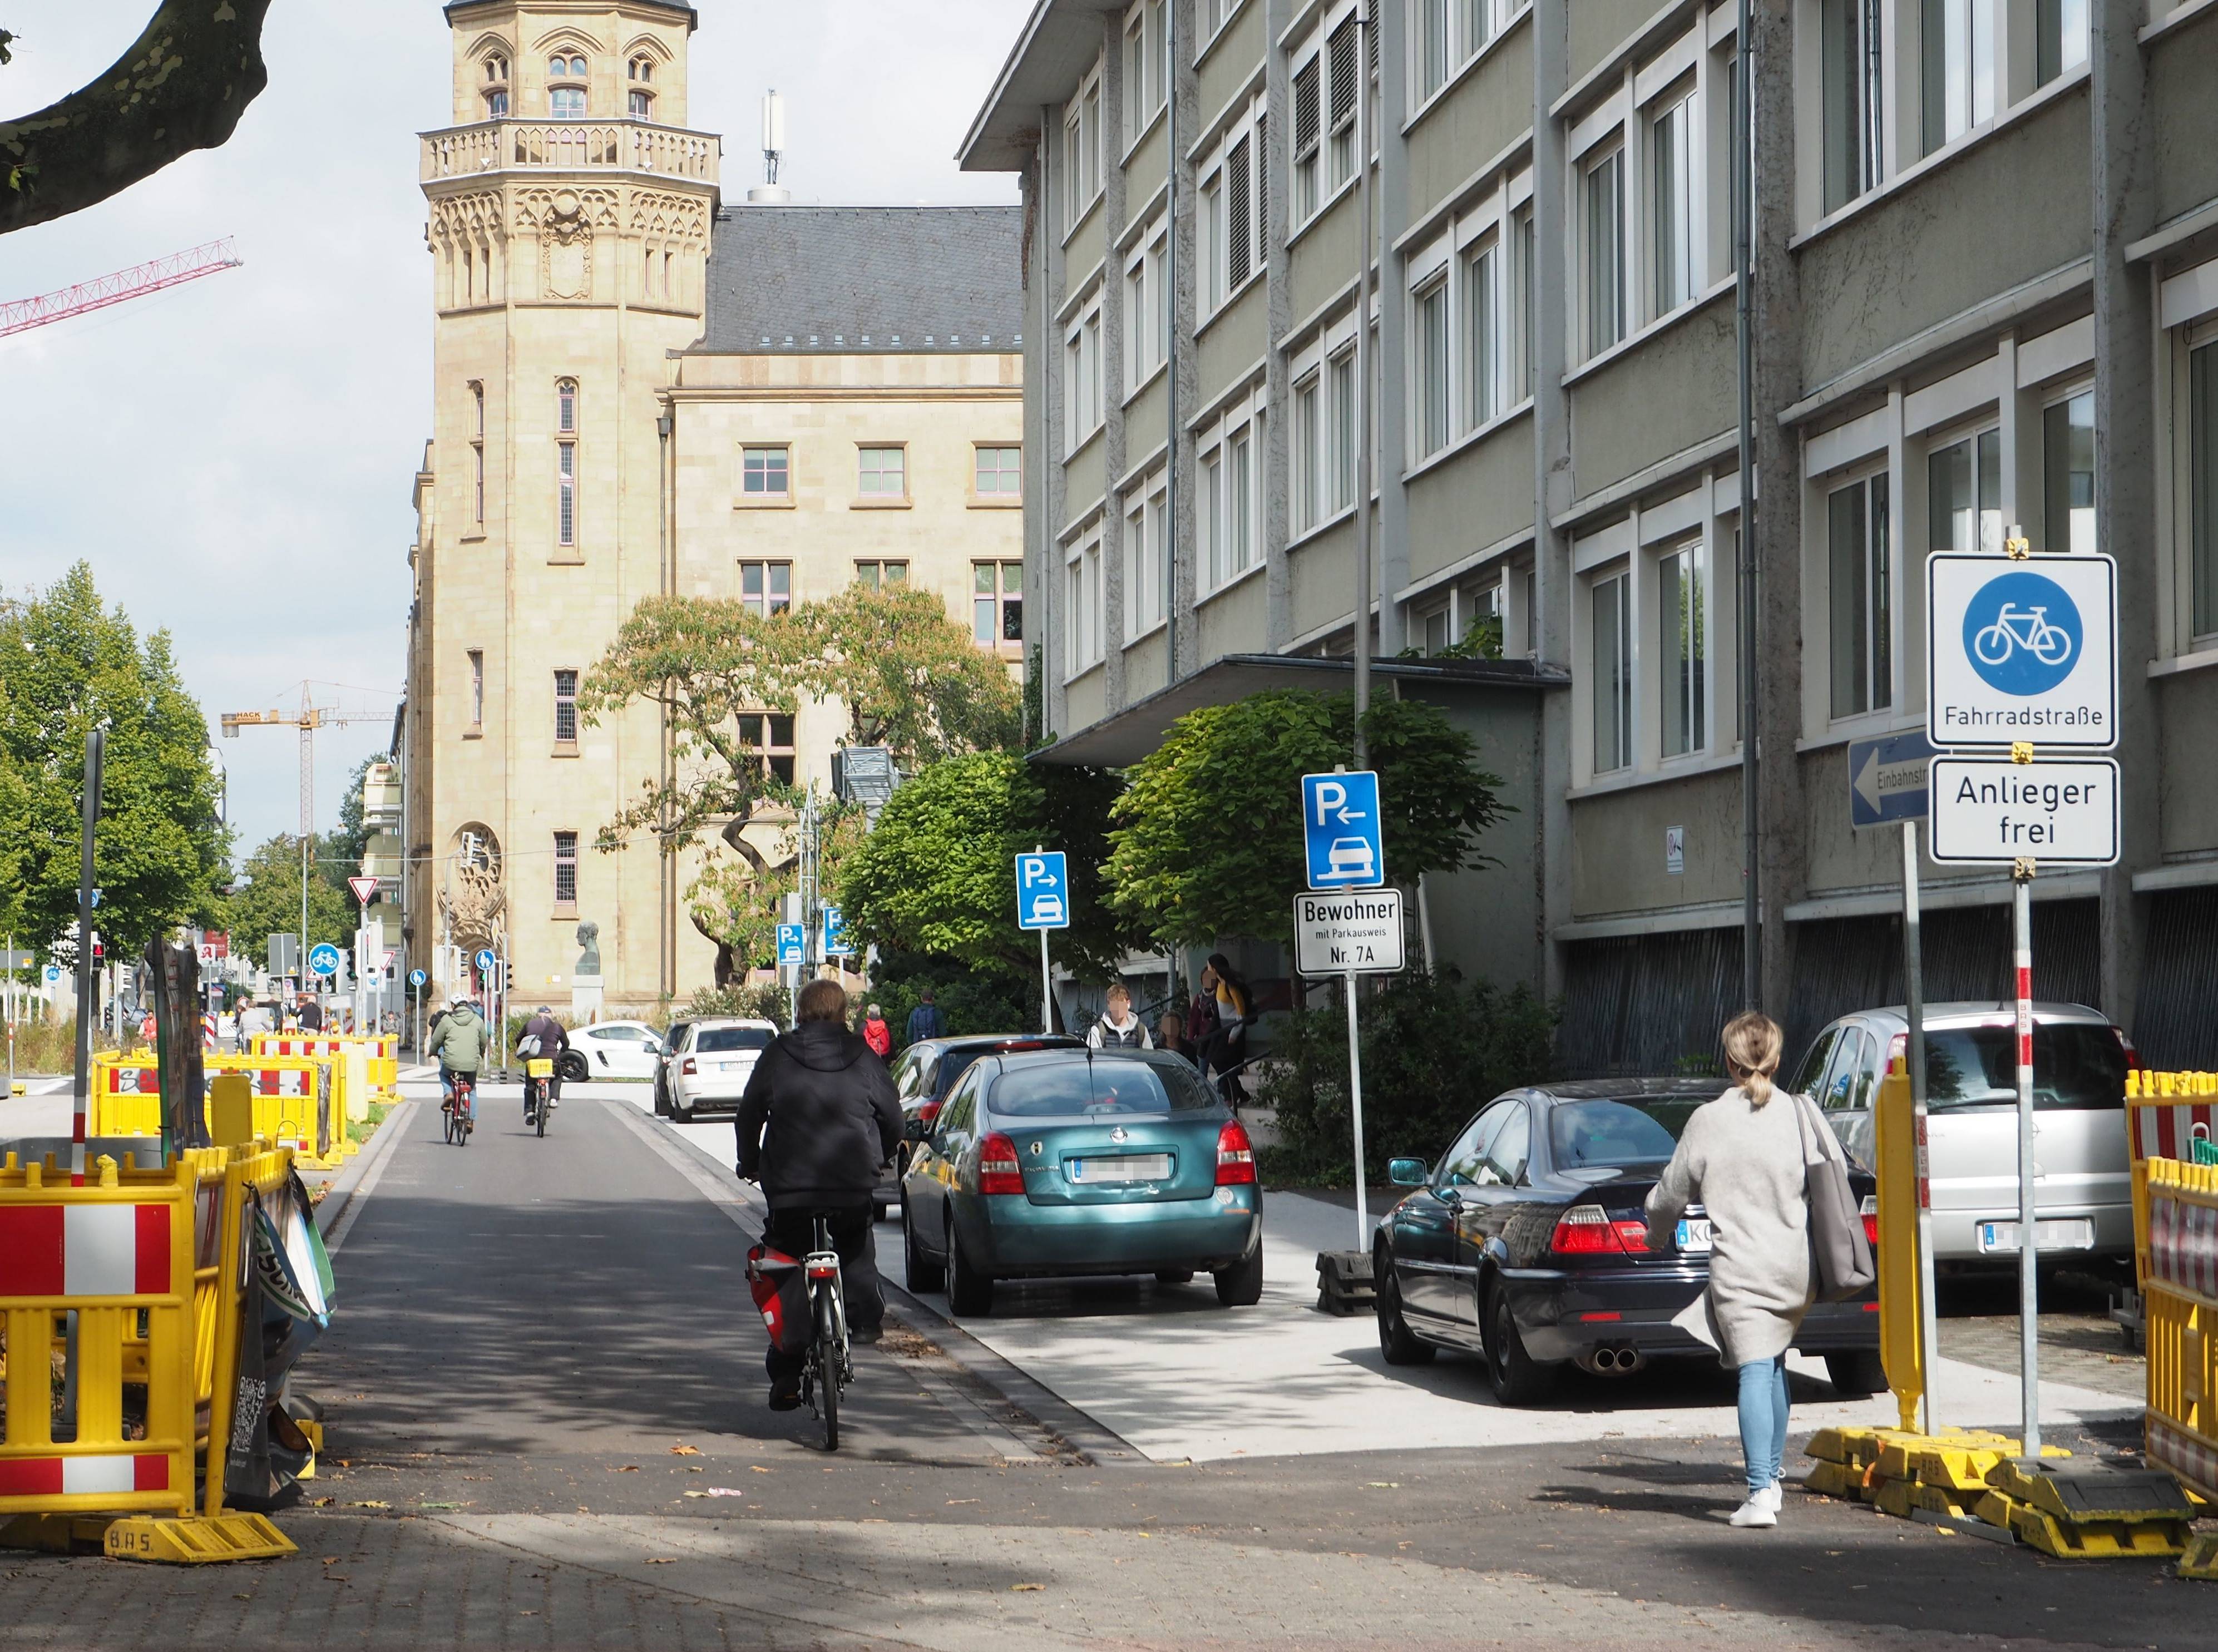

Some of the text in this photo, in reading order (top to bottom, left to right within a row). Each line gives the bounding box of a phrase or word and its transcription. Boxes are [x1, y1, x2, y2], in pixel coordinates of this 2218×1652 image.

[1945, 706, 2102, 725] Fahrradstraße
[1877, 765, 1927, 789] Einbahnstr
[1316, 782, 1346, 825] P
[1956, 776, 2096, 812] Anlieger
[2000, 816, 2054, 843] frei
[1024, 858, 1045, 888] P
[1304, 899, 1395, 922] Bewohner
[781, 927, 793, 943] P
[1316, 927, 1386, 939] mit Parkausweis
[1330, 945, 1375, 963] Nr. 7A
